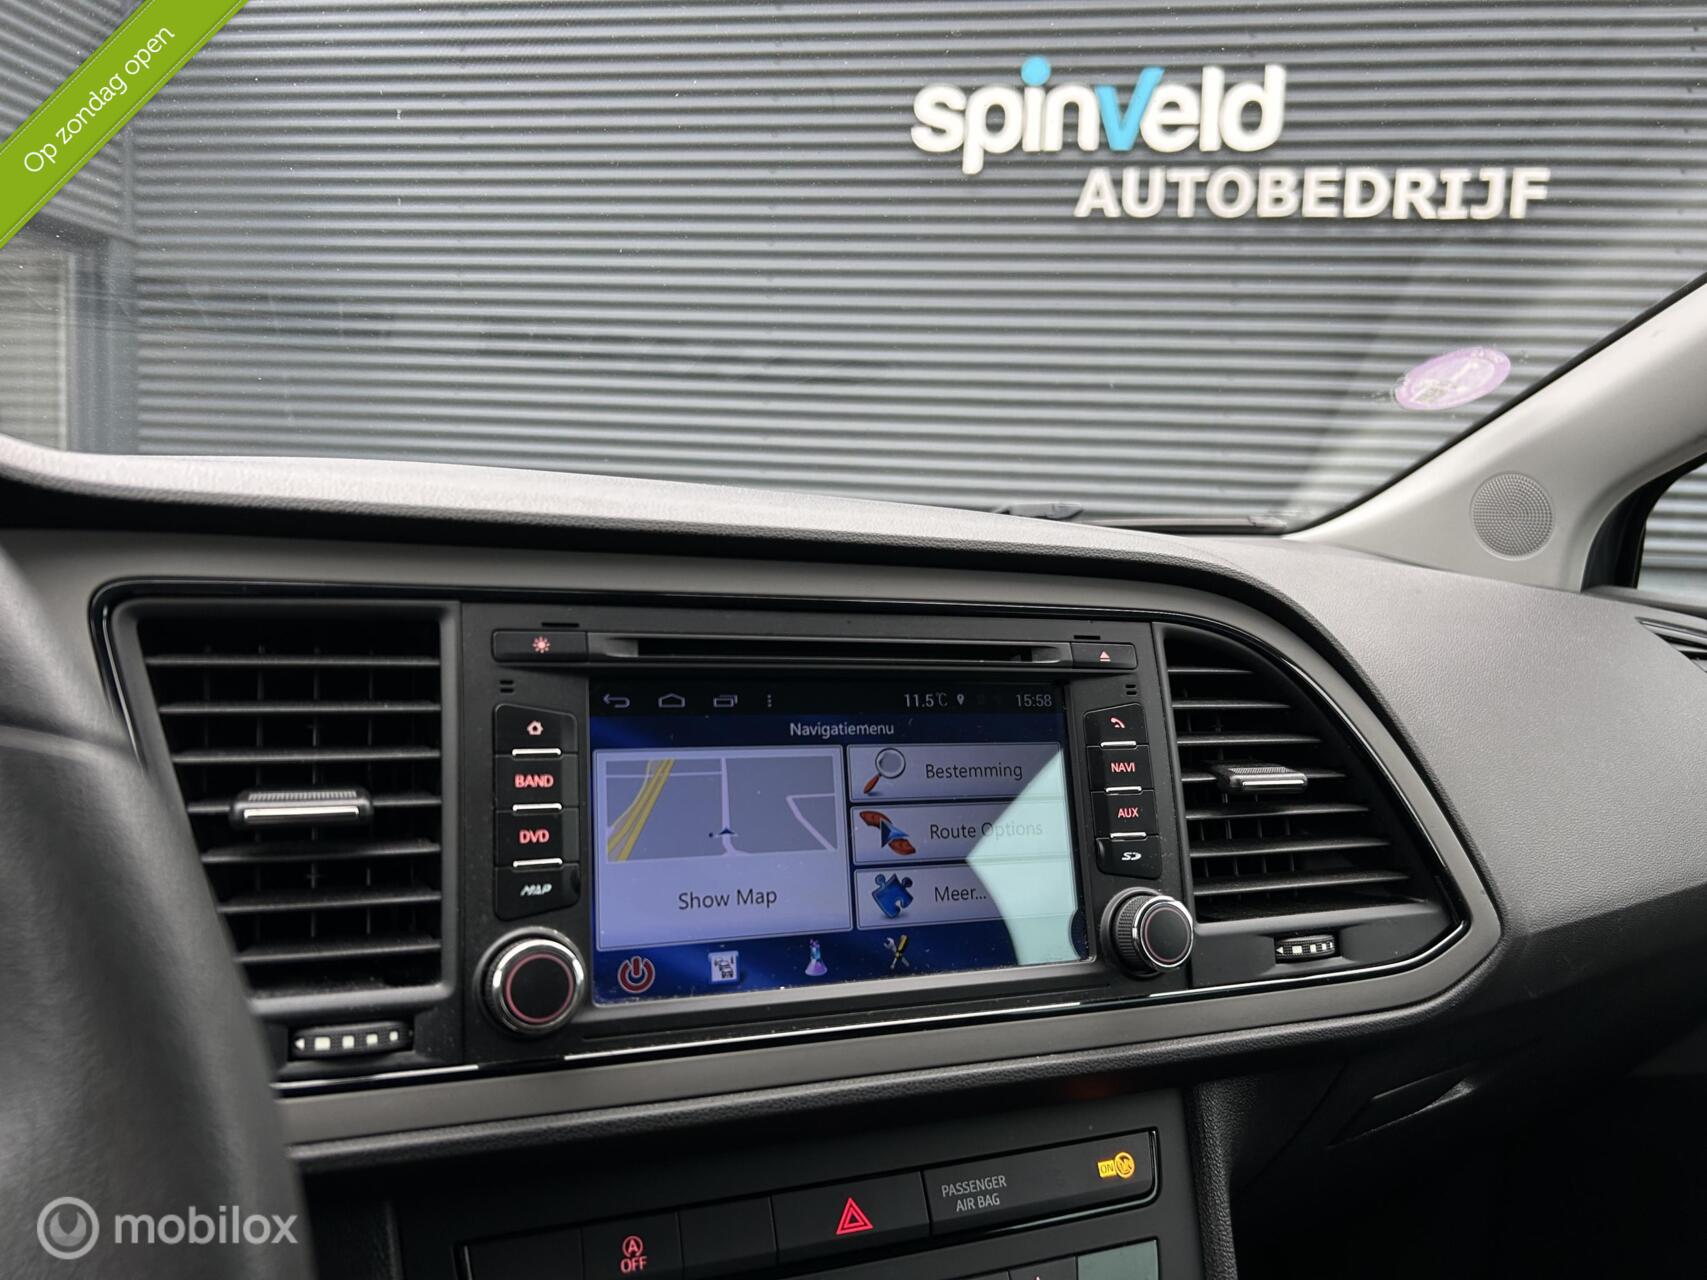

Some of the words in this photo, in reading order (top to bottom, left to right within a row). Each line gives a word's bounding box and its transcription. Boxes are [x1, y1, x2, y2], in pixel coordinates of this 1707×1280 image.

[1074, 167, 1551, 219] AUTOBEDRIJF
[1016, 694, 1053, 708] 15:58
[789, 721, 895, 739] Navigatiemenu
[925, 762, 1023, 781] Bestemming
[1111, 762, 1136, 773] NAVI
[514, 774, 554, 788] BAND
[1117, 807, 1140, 818] AUX
[519, 829, 550, 844] DVD
[930, 823, 976, 840] Route
[981, 821, 1043, 841] Options
[1121, 851, 1143, 861] SD
[520, 883, 552, 896] MAP
[678, 891, 731, 910] Show
[737, 888, 778, 907] Map
[1100, 1162, 1115, 1176] ON
[941, 1175, 1008, 1198] PASSENGER
[956, 1198, 976, 1212] AIR
[977, 1193, 1000, 1208] BAG
[620, 1256, 647, 1273] OFF
